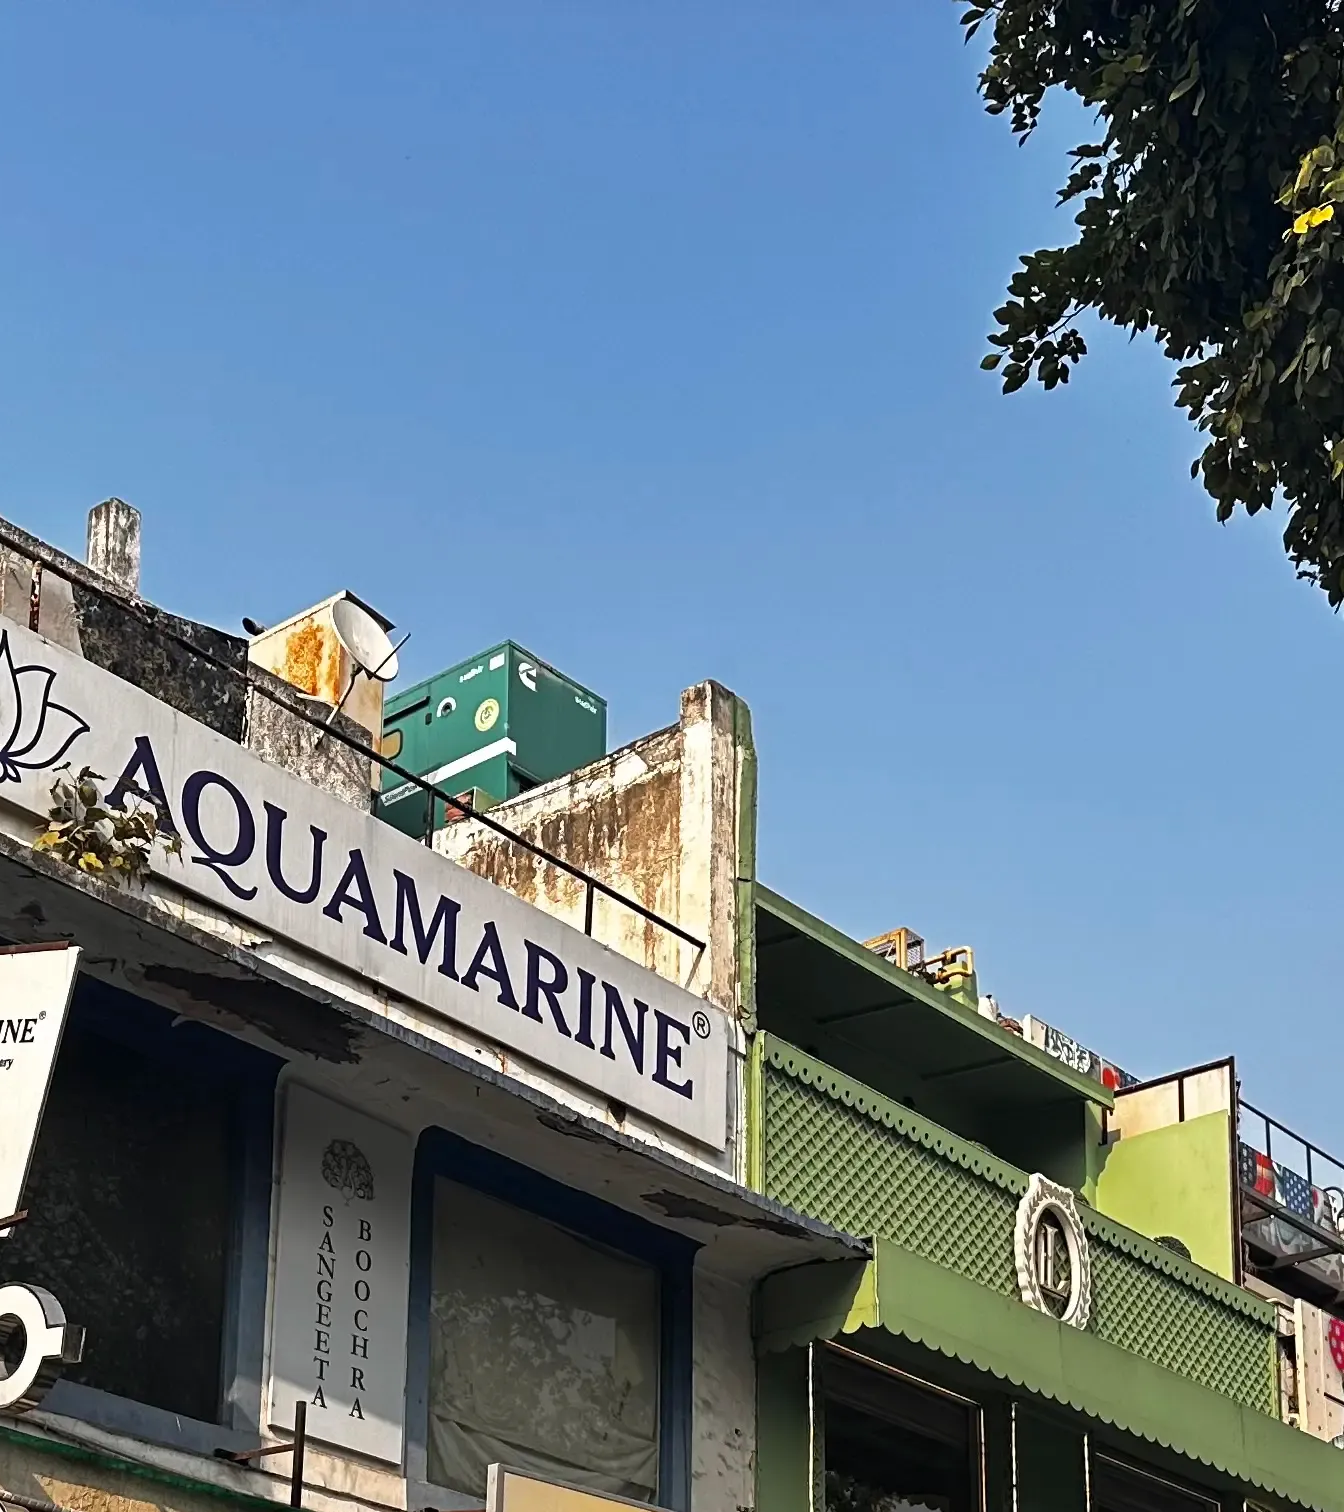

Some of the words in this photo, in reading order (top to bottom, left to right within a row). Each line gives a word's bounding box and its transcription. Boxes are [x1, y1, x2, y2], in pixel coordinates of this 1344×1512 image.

[101, 733, 696, 1102] AQUAMARINE
[311, 1204, 337, 1410] SANGEETA
[348, 1219, 374, 1422] BOOCHRA
